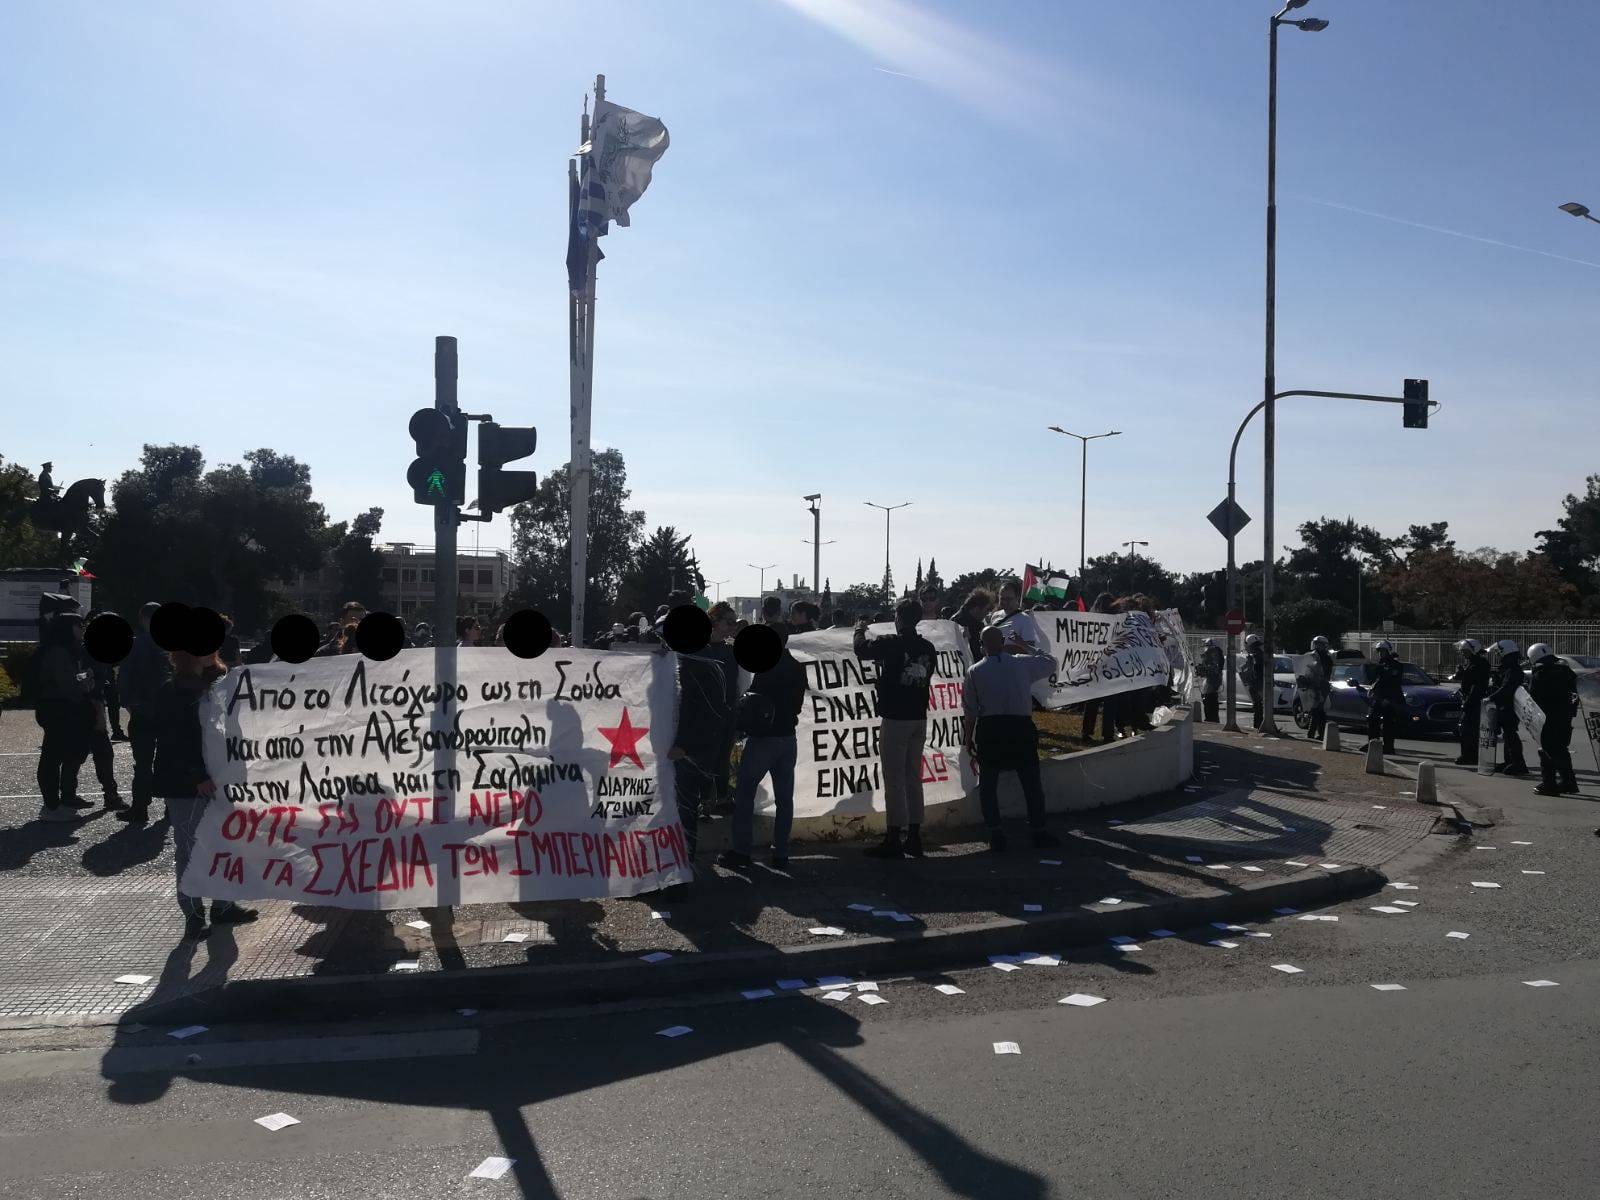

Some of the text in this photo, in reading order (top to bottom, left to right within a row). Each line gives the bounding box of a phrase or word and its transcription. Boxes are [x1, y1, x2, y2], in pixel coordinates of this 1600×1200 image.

[1056, 618, 1111, 645] ΜΗΤΕΡΕΣ
[802, 657, 880, 691] ΠΟΛΕ
[1061, 648, 1104, 672] MOTHER
[227, 660, 622, 715] Από το Λιτόχωρο ως τη Σούδα
[811, 682, 965, 723] ΕΙΝΑΙ ΝΤΟΥ
[226, 710, 546, 768] και από την Αλεξανδρούπολη
[812, 726, 881, 762] ΕΧΘΡ
[299, 762, 385, 808] Λάρισα
[393, 768, 428, 795] και
[432, 767, 461, 792] τη
[471, 750, 584, 798] Σαλαμίνα
[597, 776, 655, 797] ΔΙΑΡΚΗΣ
[816, 763, 880, 798] ΕΙΝΑΙ
[918, 753, 949, 783] ΔΩ
[222, 806, 303, 846] ΟΥΤΕ
[375, 796, 449, 834] ΟΥΤΕ
[468, 790, 543, 827] ΝΕΡΟ
[591, 799, 654, 819] ΑΓΩΝΑΣ
[208, 823, 689, 896] ΓΙΑ ΤΑ ΣΧΕΔΙΑ ΤΩΝ ΙΜΠΕΡΙΑΛΙΣΤΩΝ
